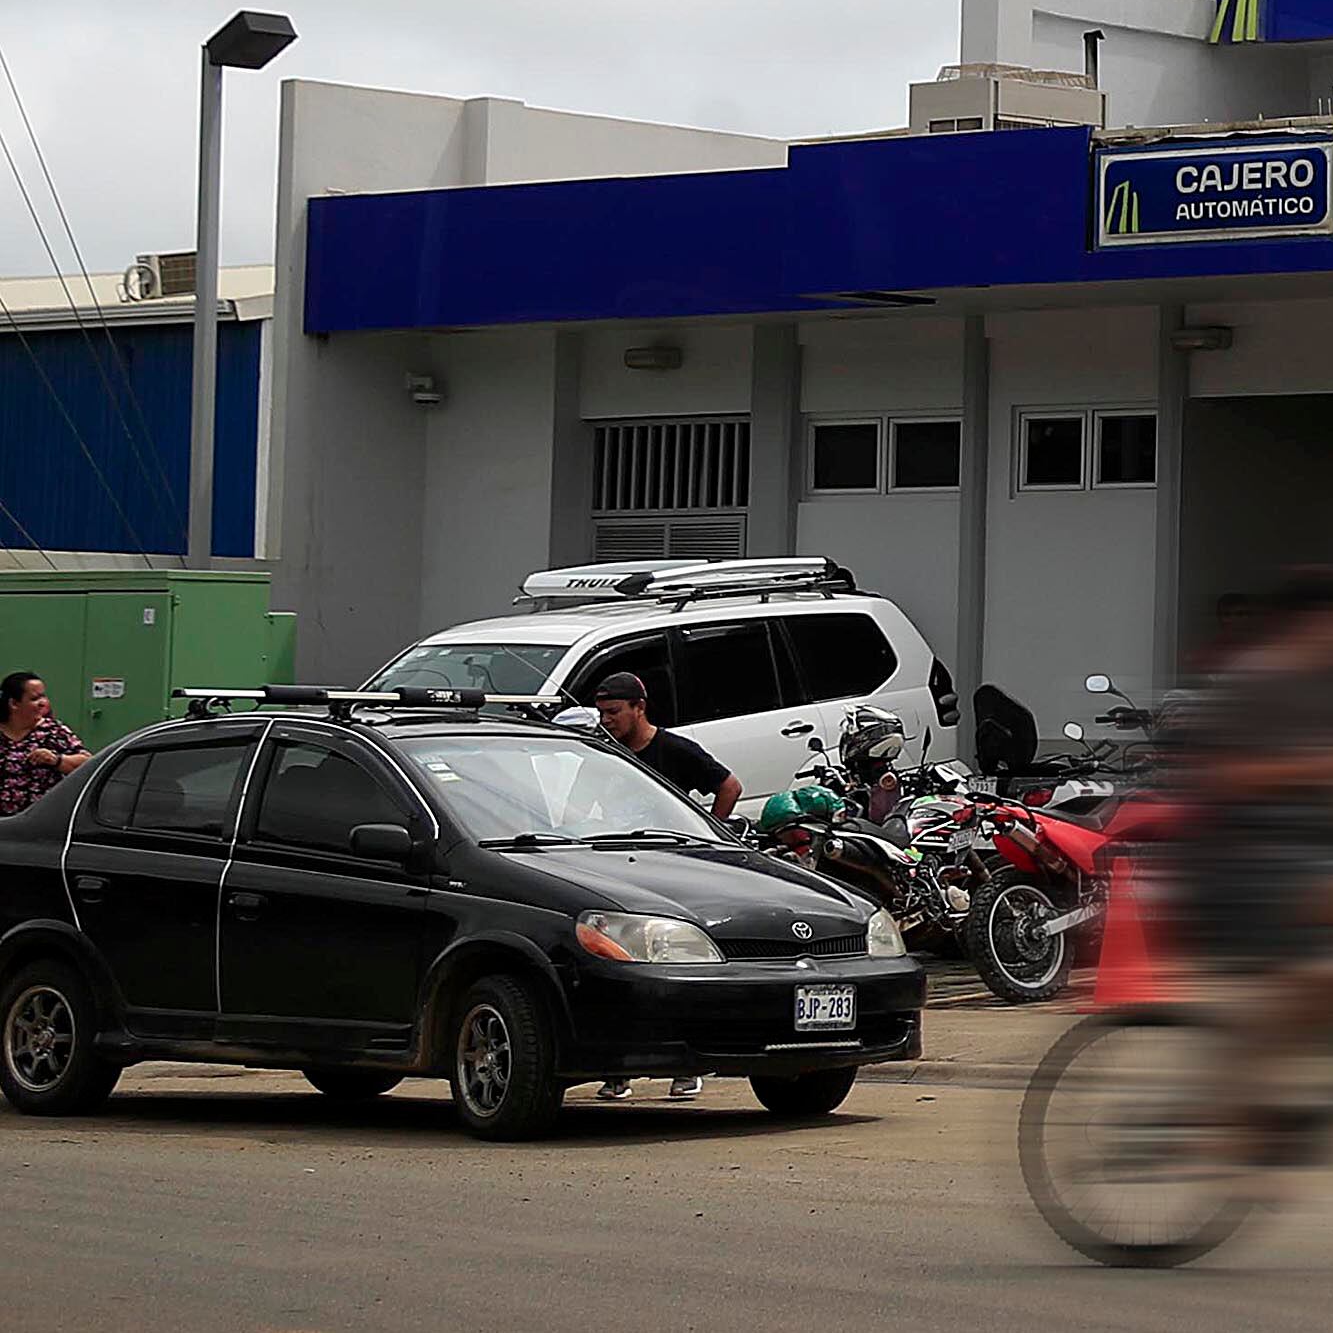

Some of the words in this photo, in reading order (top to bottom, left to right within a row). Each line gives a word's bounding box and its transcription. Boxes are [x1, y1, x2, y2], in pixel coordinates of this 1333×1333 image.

[1175, 158, 1314, 194] CAJERO
[1175, 194, 1315, 221] AUTOMÁTICO
[798, 996, 852, 1020] BJP-283
